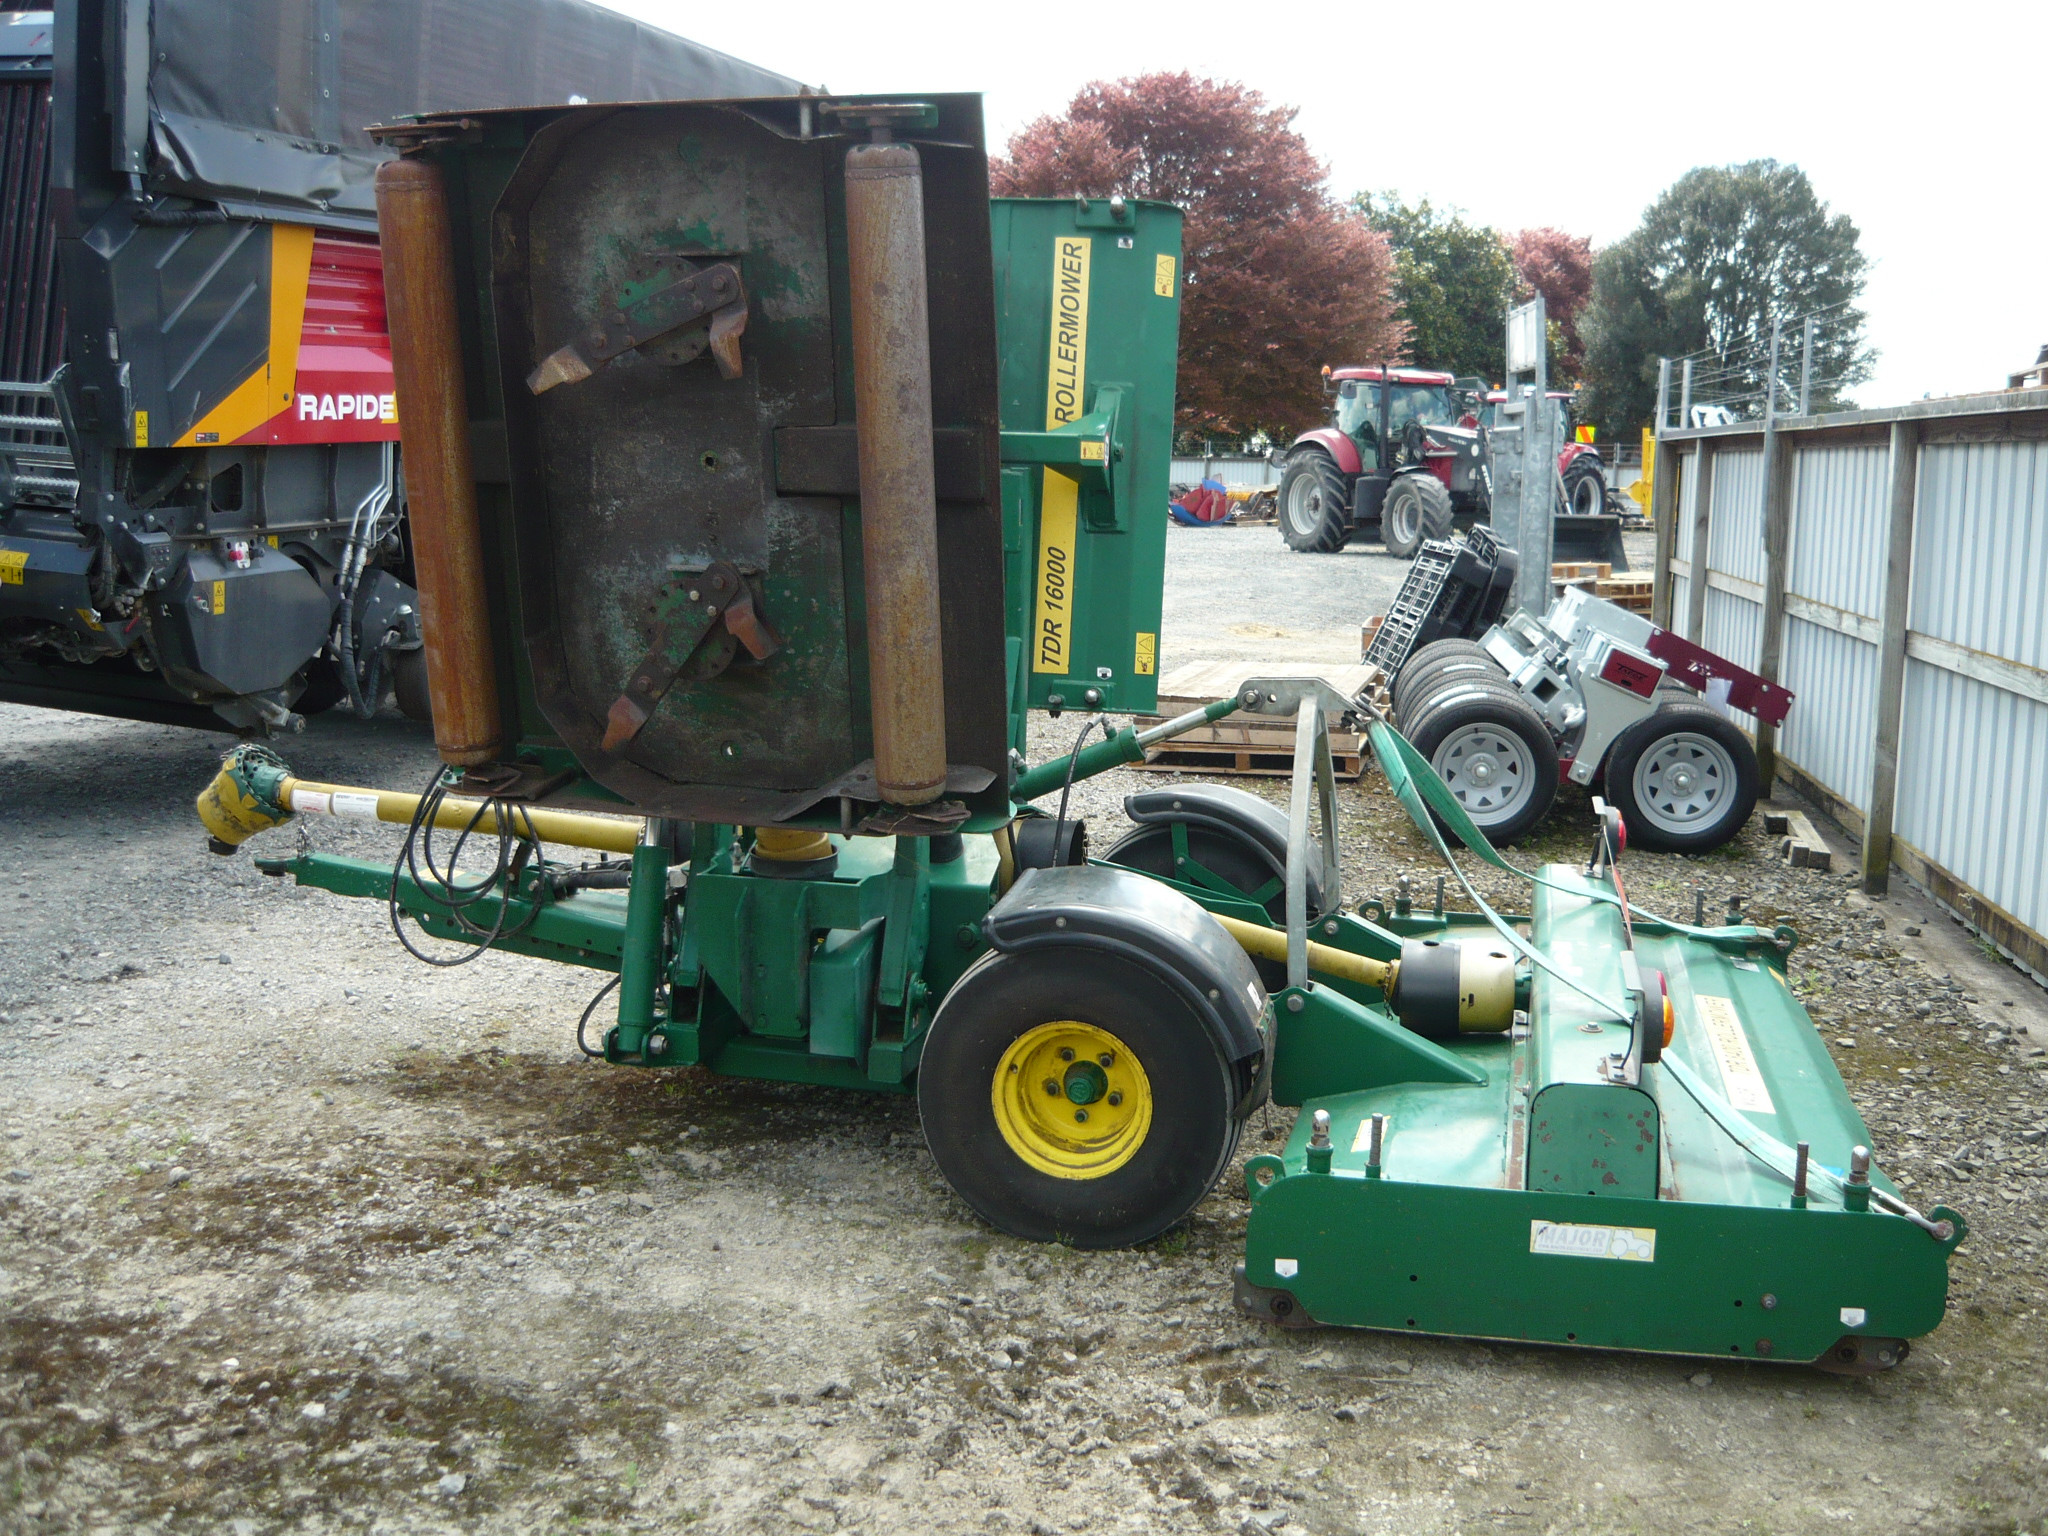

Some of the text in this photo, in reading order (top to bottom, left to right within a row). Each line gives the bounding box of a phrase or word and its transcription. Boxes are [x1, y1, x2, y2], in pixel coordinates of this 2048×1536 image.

[1054, 242, 1083, 424] ROLLERMOWER
[299, 393, 395, 421] RAPIDE
[1041, 546, 1066, 666] TDR 16000
[1538, 1225, 1608, 1249] MAJOR
